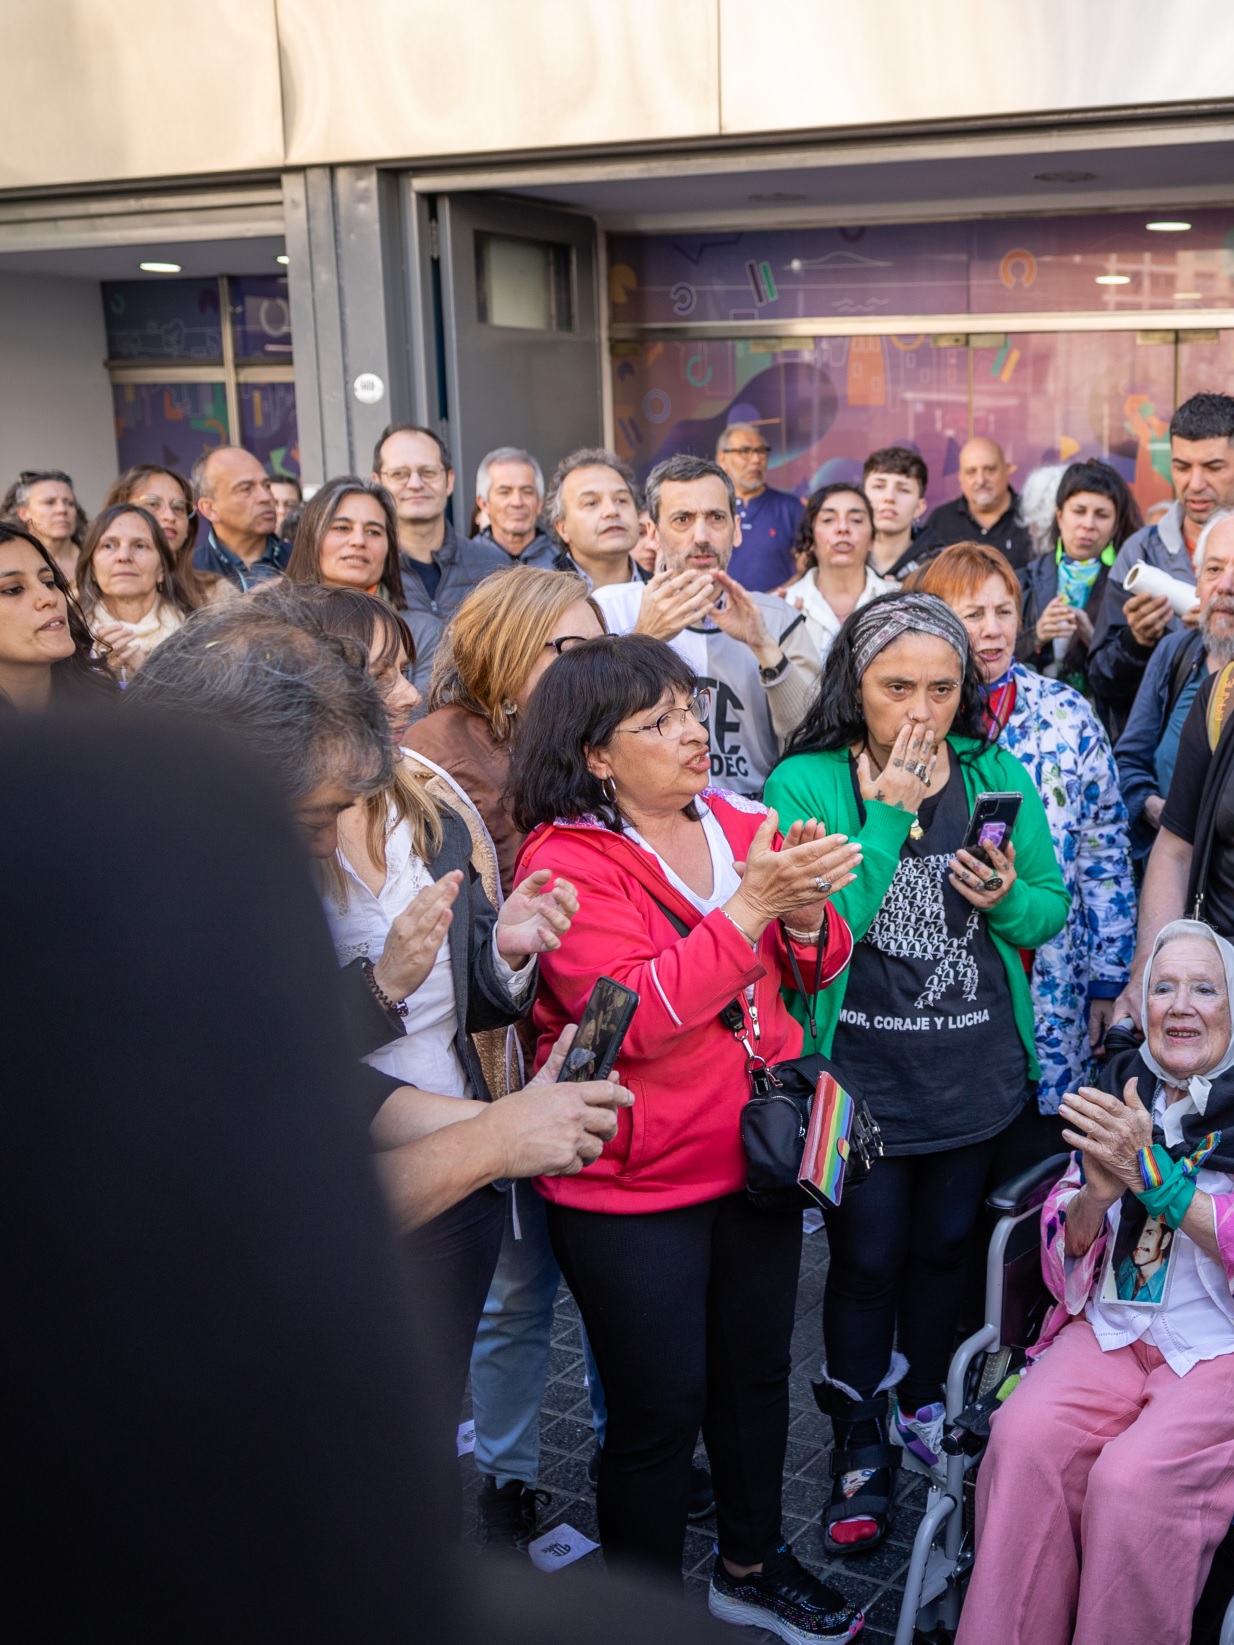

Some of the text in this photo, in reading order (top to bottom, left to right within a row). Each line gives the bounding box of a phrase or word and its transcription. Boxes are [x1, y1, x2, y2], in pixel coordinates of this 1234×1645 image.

[709, 754, 749, 777] DEC
[838, 1009, 990, 1031] MOR, CORAJE Y LUCHA
